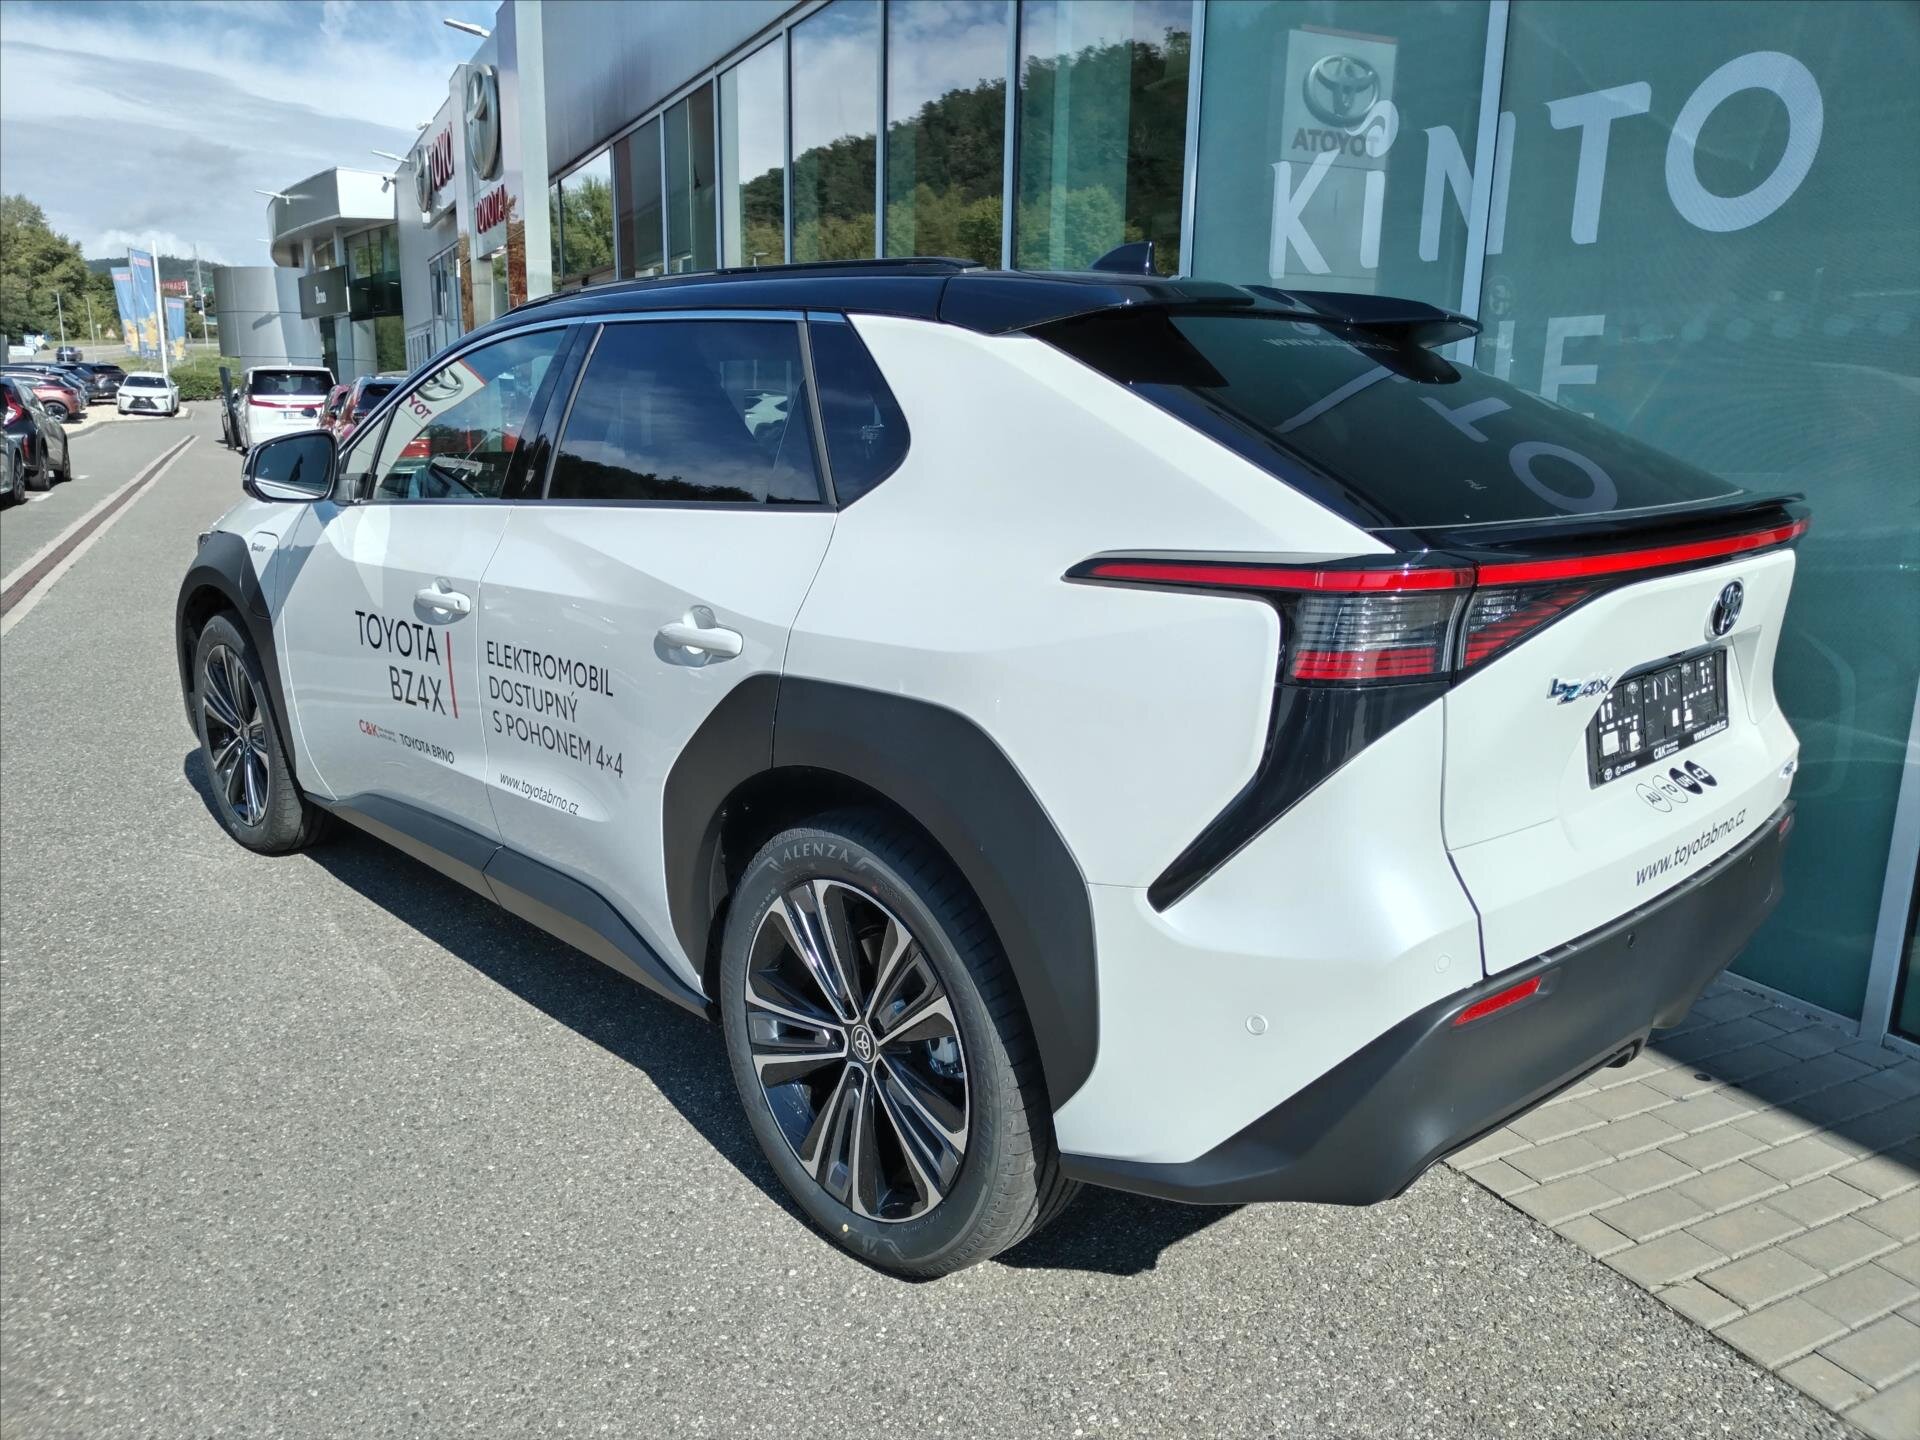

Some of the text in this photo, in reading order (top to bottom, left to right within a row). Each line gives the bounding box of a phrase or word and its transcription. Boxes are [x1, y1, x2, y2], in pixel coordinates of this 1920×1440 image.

[428, 122, 455, 192] TOYO
[355, 609, 441, 666] TOYOTA
[388, 665, 446, 716] BZ4X
[486, 640, 614, 697] ELEKTROMOBIL
[488, 675, 578, 723] DOSTUPNÝ
[399, 733, 431, 755] TOYOTA
[431, 744, 455, 765] BRNO
[492, 710, 503, 733] S
[506, 714, 591, 766] POHONEM
[500, 772, 579, 816] www.toyotabrno.cz
[1661, 783, 1678, 796] TO
[783, 842, 849, 862] ALENZA
[1635, 807, 1747, 887] www.toyotabrno.cz
